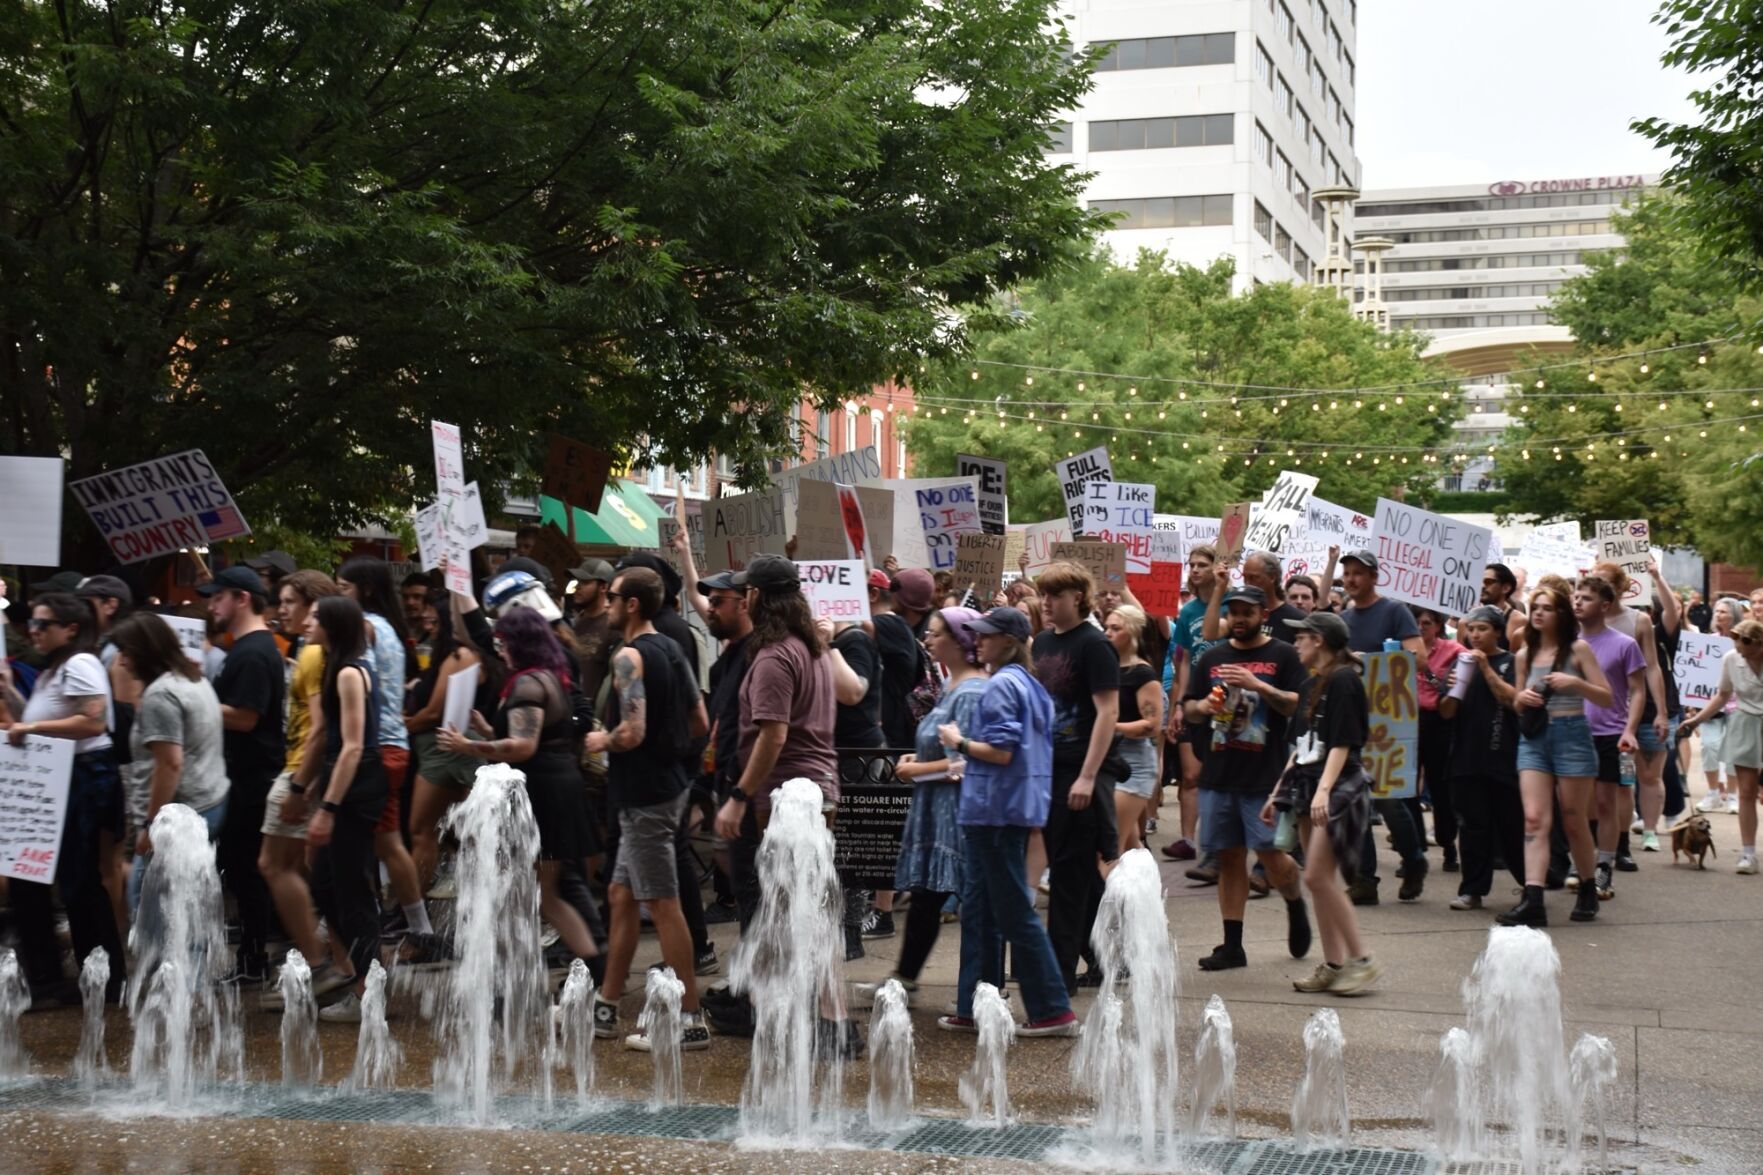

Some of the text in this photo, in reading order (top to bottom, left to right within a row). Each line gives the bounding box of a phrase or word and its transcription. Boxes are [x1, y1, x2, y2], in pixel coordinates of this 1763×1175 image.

[1530, 175, 1645, 194] CROWNE PLAZA
[1067, 455, 1100, 479] FULL
[73, 452, 214, 508] IMMIGRANTS
[1090, 483, 1107, 499] I
[91, 481, 228, 534] BUILT THIS
[714, 494, 787, 538] ABOLISH
[987, 502, 1003, 513] OUR
[1086, 505, 1153, 527] my ICE
[1351, 514, 1368, 529] ARE
[1599, 520, 1628, 539] KEEP
[109, 515, 204, 561] COUNTRY
[926, 532, 952, 548] on
[958, 531, 1003, 551] LIBERTY
[1247, 514, 1289, 553] MEANS
[1384, 506, 1412, 537] NO
[1419, 518, 1457, 550] ONE
[1463, 531, 1483, 560] IS
[1053, 545, 1115, 562] ABOLISH
[1377, 536, 1472, 581] ILLEGAL ON
[1604, 540, 1650, 558] FAMILIES
[956, 559, 996, 575] JUSTICE
[1375, 561, 1476, 614] STOLEN LAND
[1705, 644, 1722, 659] IS
[841, 796, 912, 805] ET SQUARE INTE
